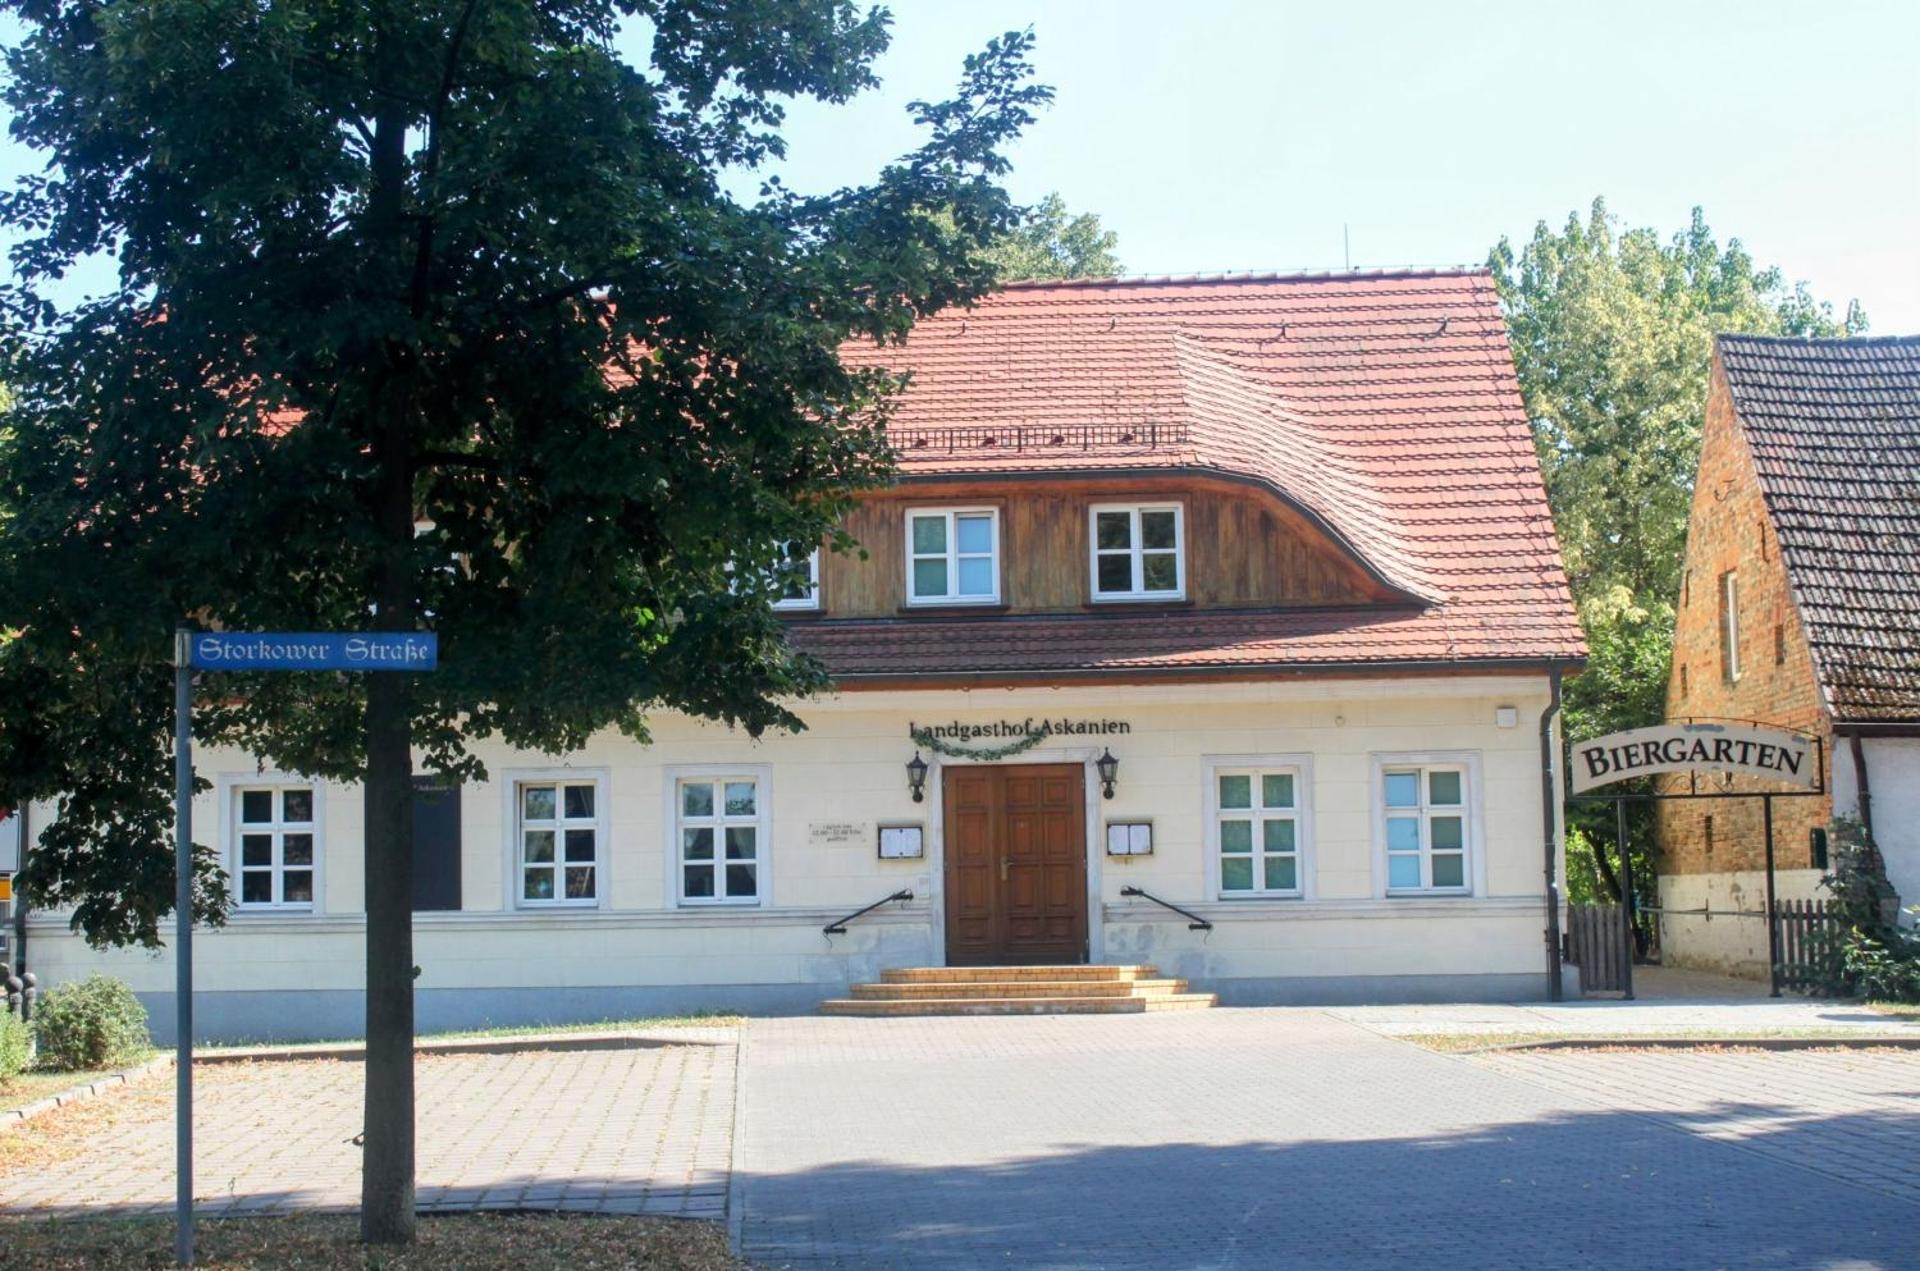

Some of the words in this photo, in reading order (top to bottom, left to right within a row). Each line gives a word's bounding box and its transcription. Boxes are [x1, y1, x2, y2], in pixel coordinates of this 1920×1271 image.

[200, 638, 330, 660] Storkower
[346, 638, 428, 663] Straße
[909, 719, 1033, 742] Landgasthof
[1042, 718, 1131, 735] Askanien
[1581, 738, 1804, 778] BIERGARTEN
